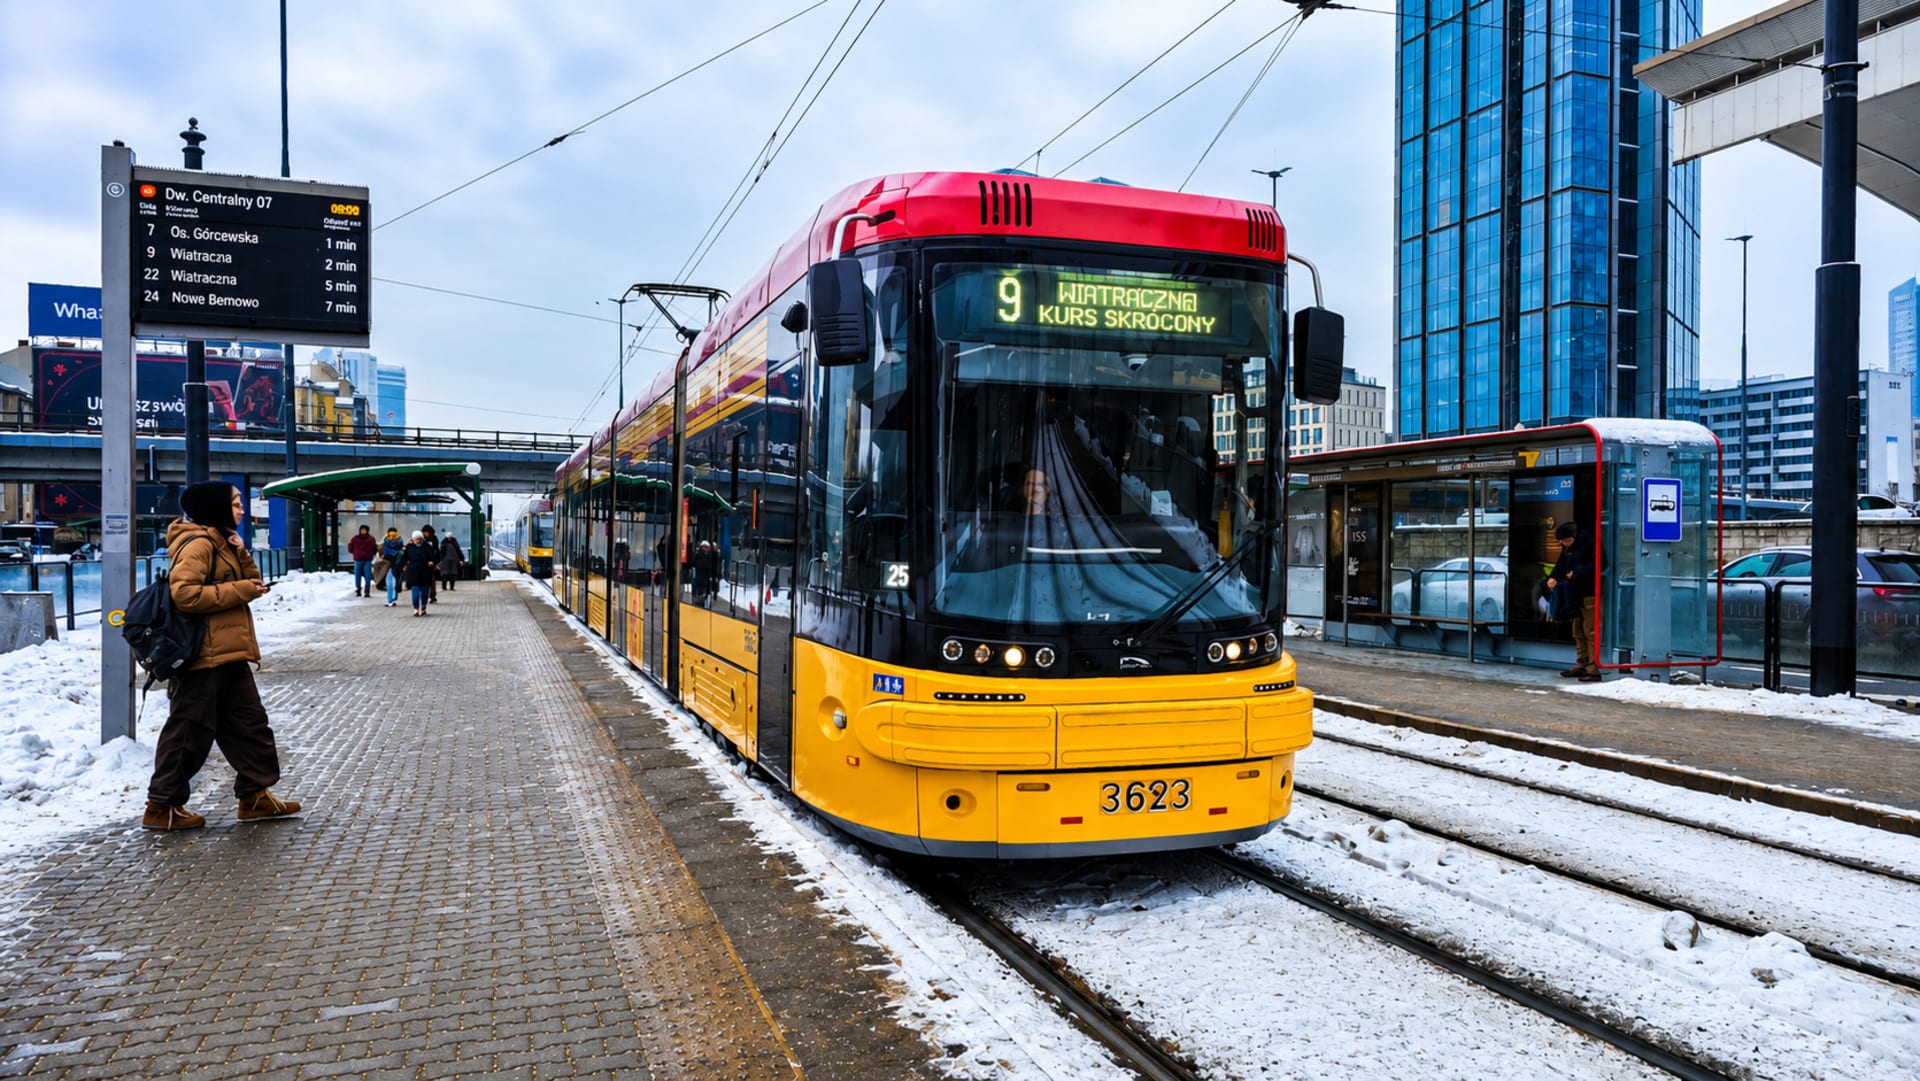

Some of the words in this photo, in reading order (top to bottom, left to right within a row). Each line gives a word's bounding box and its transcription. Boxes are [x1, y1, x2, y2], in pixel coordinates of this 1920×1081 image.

[165, 187, 189, 202] Dw.
[192, 190, 253, 209] Centralny
[256, 195, 273, 209] 07
[147, 223, 155, 236] 7
[170, 225, 190, 239] Os.
[326, 238, 332, 249] 1
[335, 238, 357, 251] min
[146, 246, 156, 258] 9
[325, 258, 333, 271] 2
[335, 259, 357, 272] min
[144, 267, 160, 281] 22
[170, 269, 237, 286] Wiatraczna
[325, 279, 333, 292] 5
[335, 280, 357, 293] min
[144, 289, 160, 302] 24
[172, 291, 206, 305] Nowe
[325, 300, 333, 312] 7
[335, 301, 357, 314] min
[999, 276, 1021, 323] 9
[1039, 305, 1097, 327] KURS
[887, 564, 909, 587] 25
[1101, 779, 1190, 814] 3623
